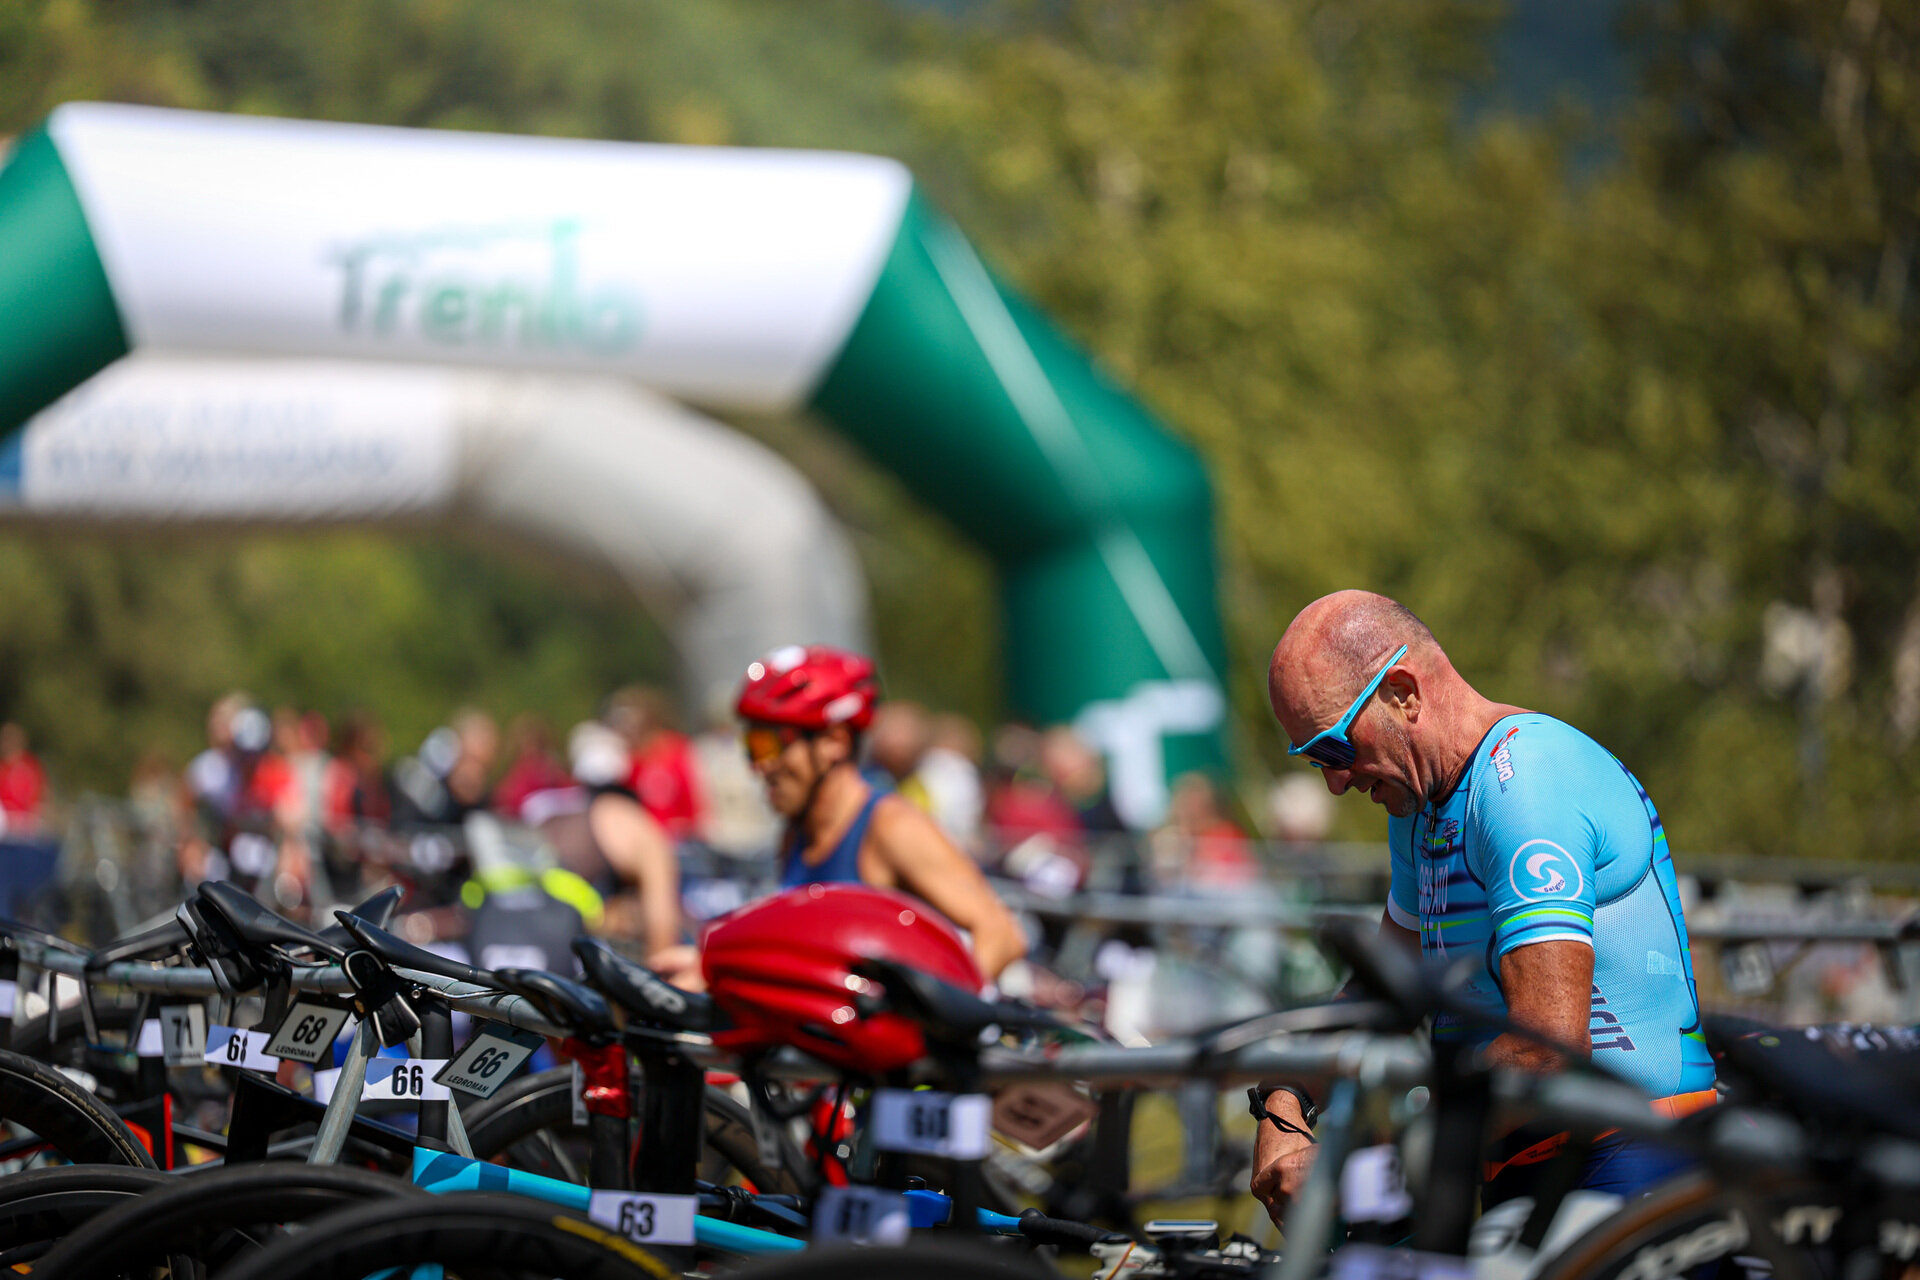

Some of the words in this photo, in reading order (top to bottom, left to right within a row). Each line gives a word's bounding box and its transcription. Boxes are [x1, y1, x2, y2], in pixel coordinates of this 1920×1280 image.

[171, 1016, 193, 1048] 71
[293, 1014, 328, 1045] 68
[467, 1047, 510, 1079] 66
[392, 1065, 424, 1096] 66
[448, 1073, 490, 1094] LEDROMAN
[620, 1201, 655, 1237] 63
